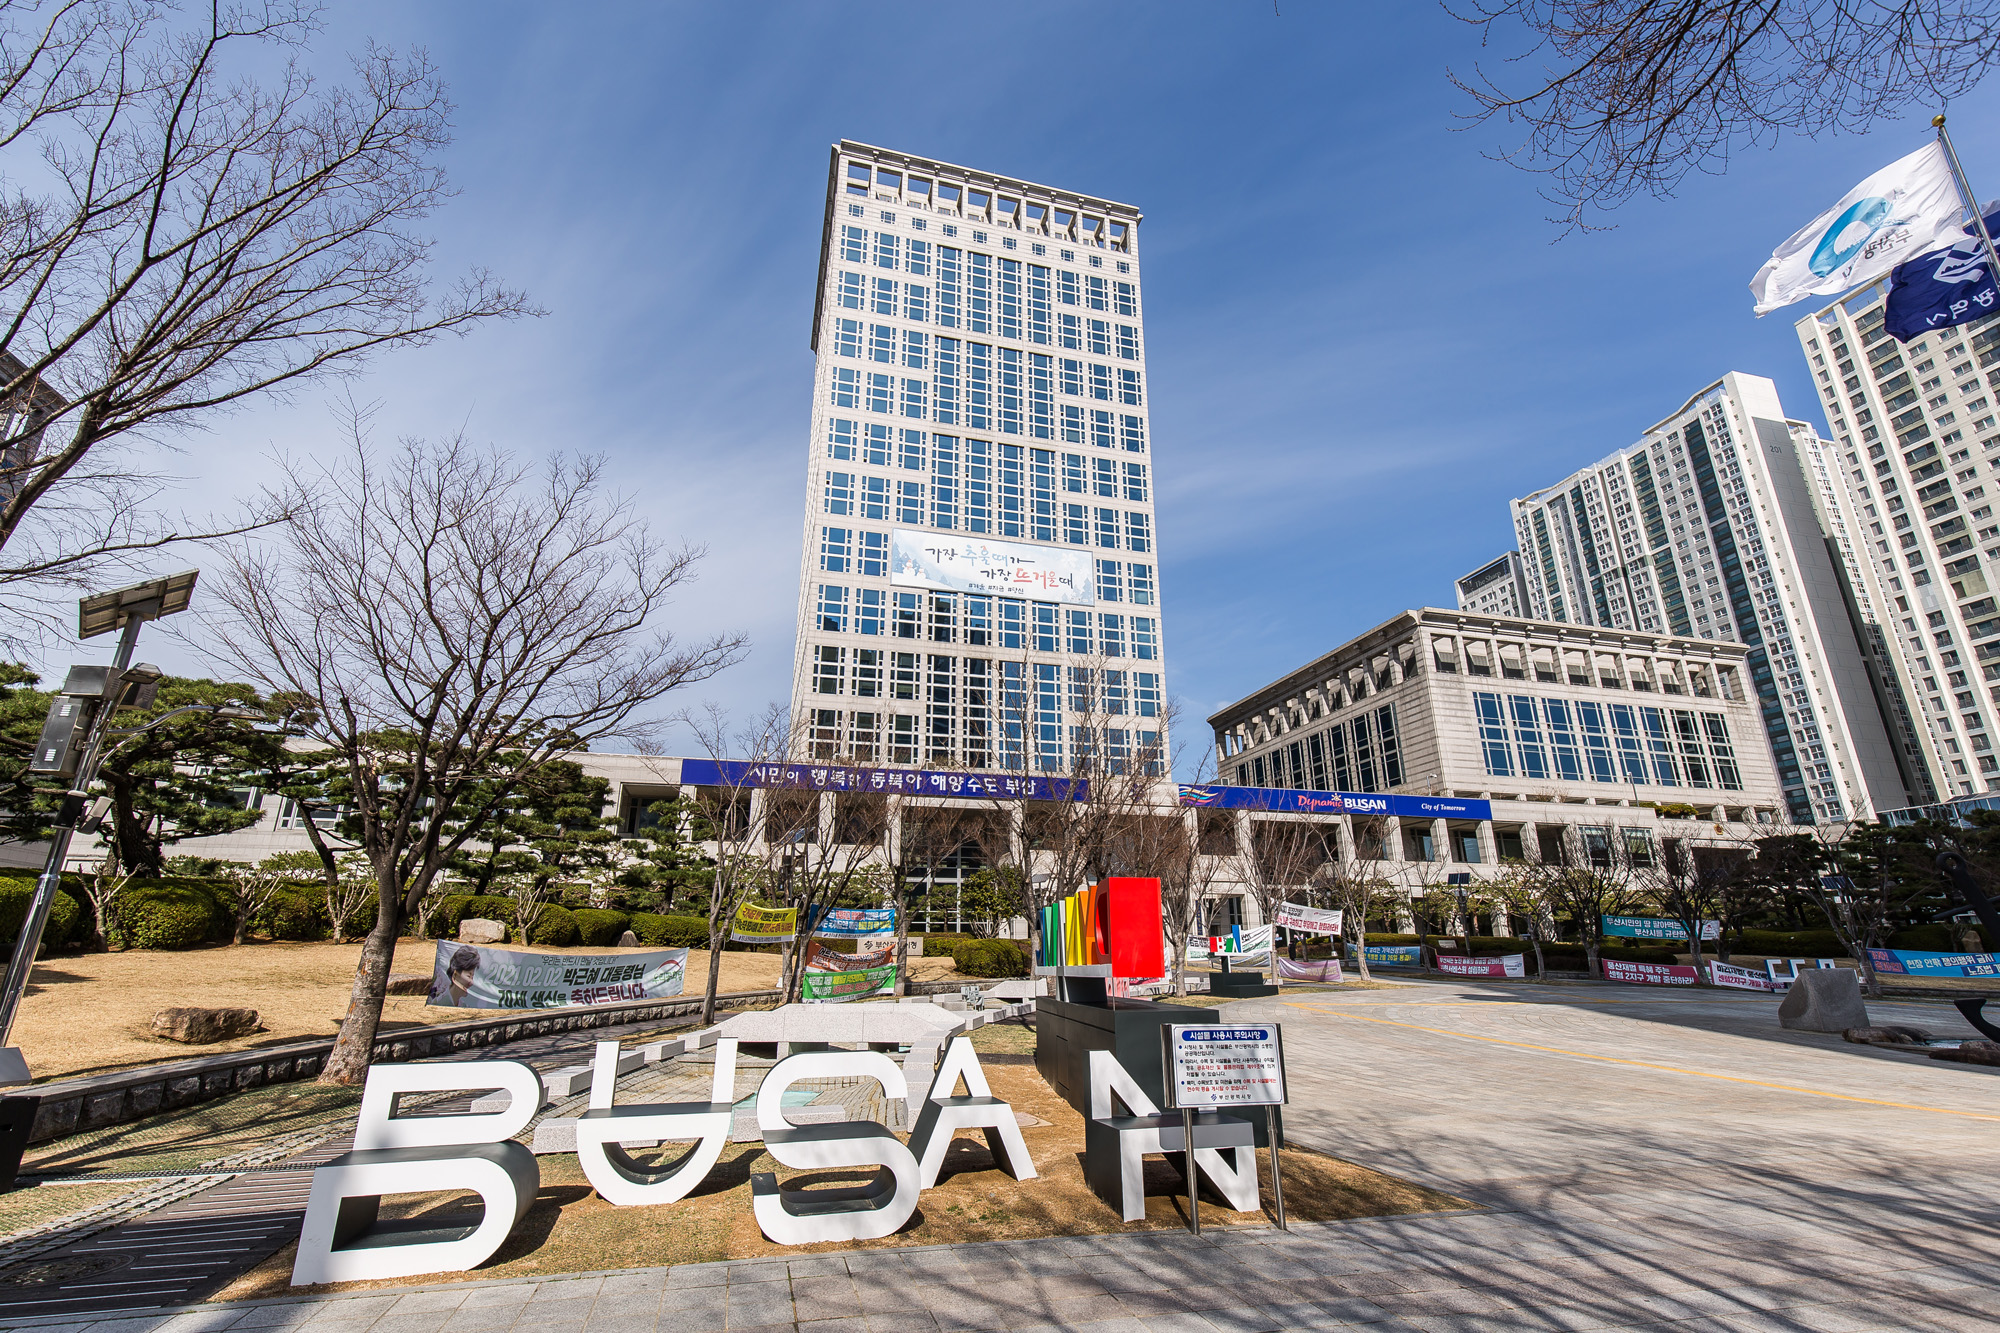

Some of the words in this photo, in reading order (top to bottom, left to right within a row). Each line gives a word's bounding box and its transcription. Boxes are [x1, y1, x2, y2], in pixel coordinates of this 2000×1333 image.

[1769, 445, 1782, 453] 201
[925, 548, 958, 563] 가장
[980, 568, 1012, 582] 가장
[749, 766, 799, 784] 시민이
[811, 768, 861, 787] 행복한
[871, 772, 922, 790] 동북아
[930, 774, 997, 793] 해양수도
[1005, 778, 1037, 795] 부산
[1297, 793, 1344, 811] Dynamic
[1344, 797, 1387, 811] BUSAN
[1421, 803, 1432, 811] City
[1606, 917, 1642, 927] 부산시민의
[1643, 920, 1651, 928] 땅
[1652, 920, 1682, 930] 팔아먹는
[1634, 928, 1663, 937] 부산시를
[1665, 929, 1689, 938] 규탄한
[1906, 959, 1924, 969] 현장
[1941, 954, 1976, 967] 쟁의행위
[1975, 953, 1995, 964] 금지
[563, 967, 600, 986] 박근혜
[600, 963, 646, 983] 대통령님
[1655, 966, 1670, 975] 주는
[1967, 964, 1994, 976] 노조법
[1625, 973, 1645, 981] 2지구
[1646, 974, 1661, 983] 개발
[1663, 975, 1694, 985] 중단하라!
[498, 989, 528, 1008] 70세
[531, 990, 567, 1008] 생신을
[570, 983, 648, 1006] 축하드립니다.
[1190, 1031, 1211, 1040] 시설물
[1212, 1031, 1233, 1040] 사용시
[1234, 1030, 1261, 1040] 주의사항
[290, 1036, 1260, 1286] BUSAN
